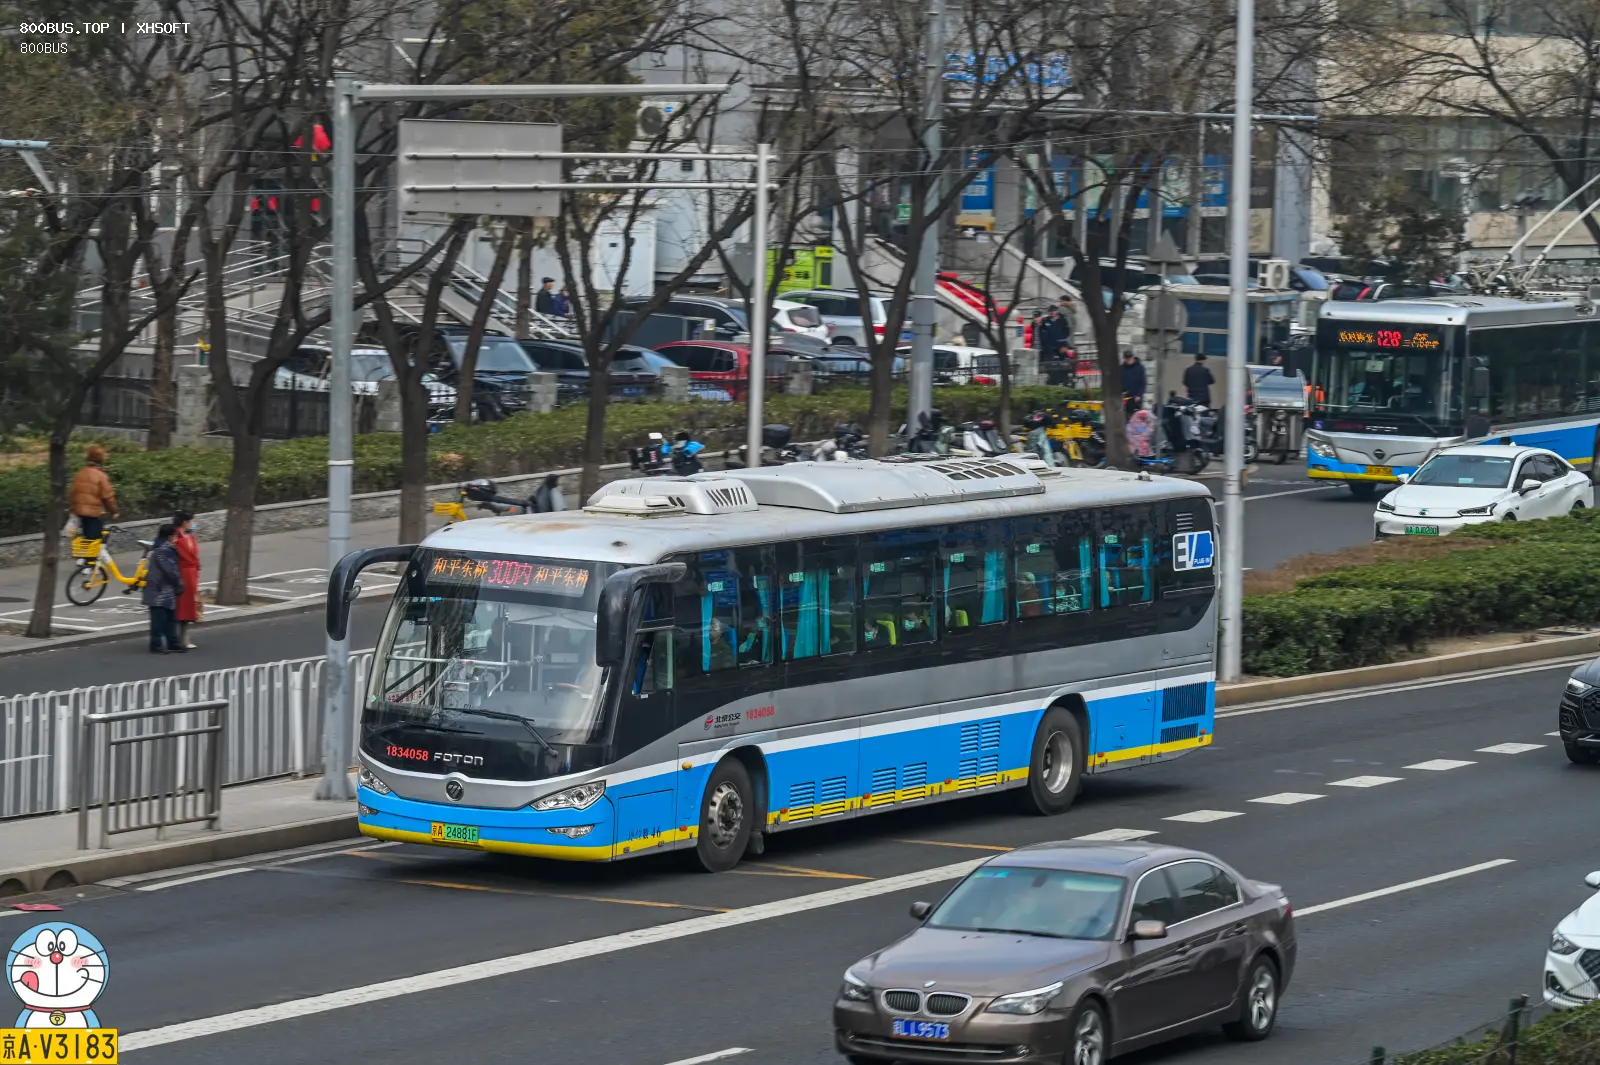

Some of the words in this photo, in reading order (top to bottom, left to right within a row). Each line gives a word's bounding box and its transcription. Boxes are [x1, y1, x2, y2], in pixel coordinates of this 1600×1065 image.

[1377, 330, 1402, 347] 128
[433, 557, 488, 578] 和平东桥
[488, 559, 532, 586] 300内
[535, 566, 589, 588] 和平东桥
[746, 706, 775, 720] 1834058
[386, 745, 429, 761] 1834058
[433, 752, 484, 766] FOTON
